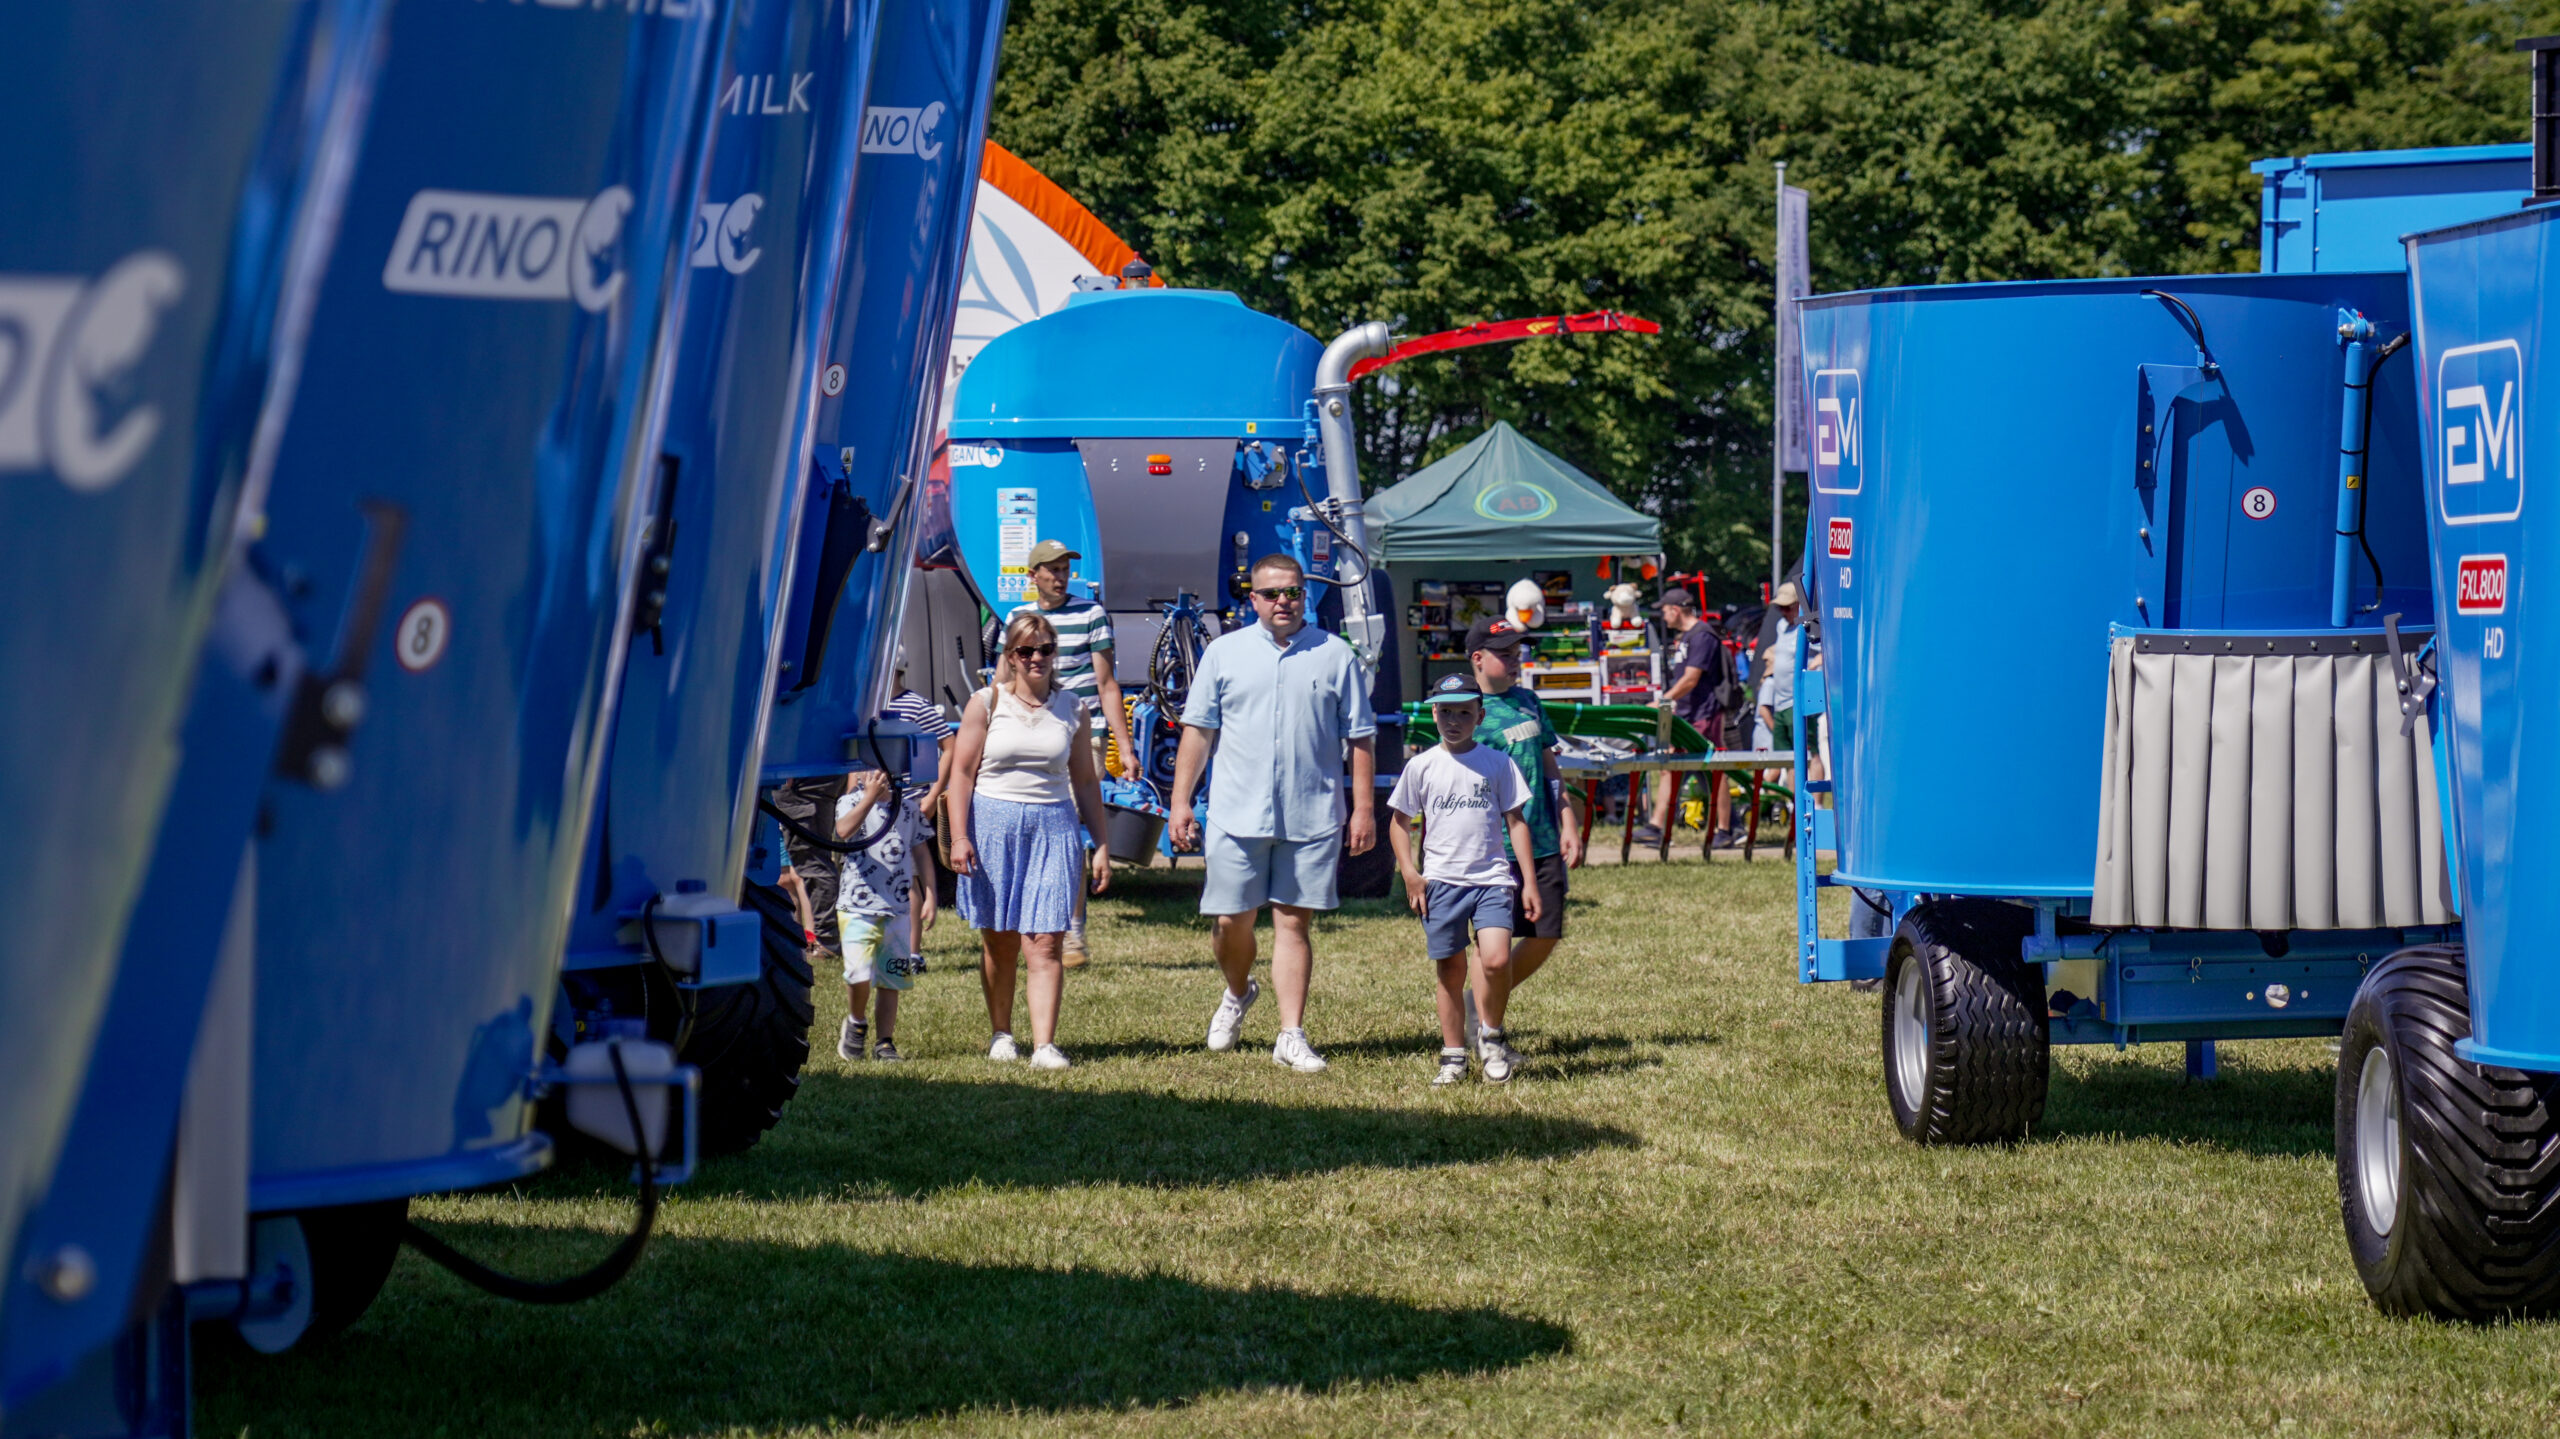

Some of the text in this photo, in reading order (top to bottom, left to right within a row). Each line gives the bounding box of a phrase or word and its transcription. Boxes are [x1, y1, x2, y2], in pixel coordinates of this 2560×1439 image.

[407, 211, 562, 282] RINO
[830, 370, 840, 390] 8
[1818, 398, 1858, 466] EM
[2446, 380, 2516, 485] EM
[2253, 494, 2266, 512] 8
[1830, 527, 1851, 550] FX800
[1840, 566, 1852, 589] HD
[2460, 569, 2504, 601] FXL800
[411, 615, 433, 656] 8
[2483, 627, 2504, 659] HD
